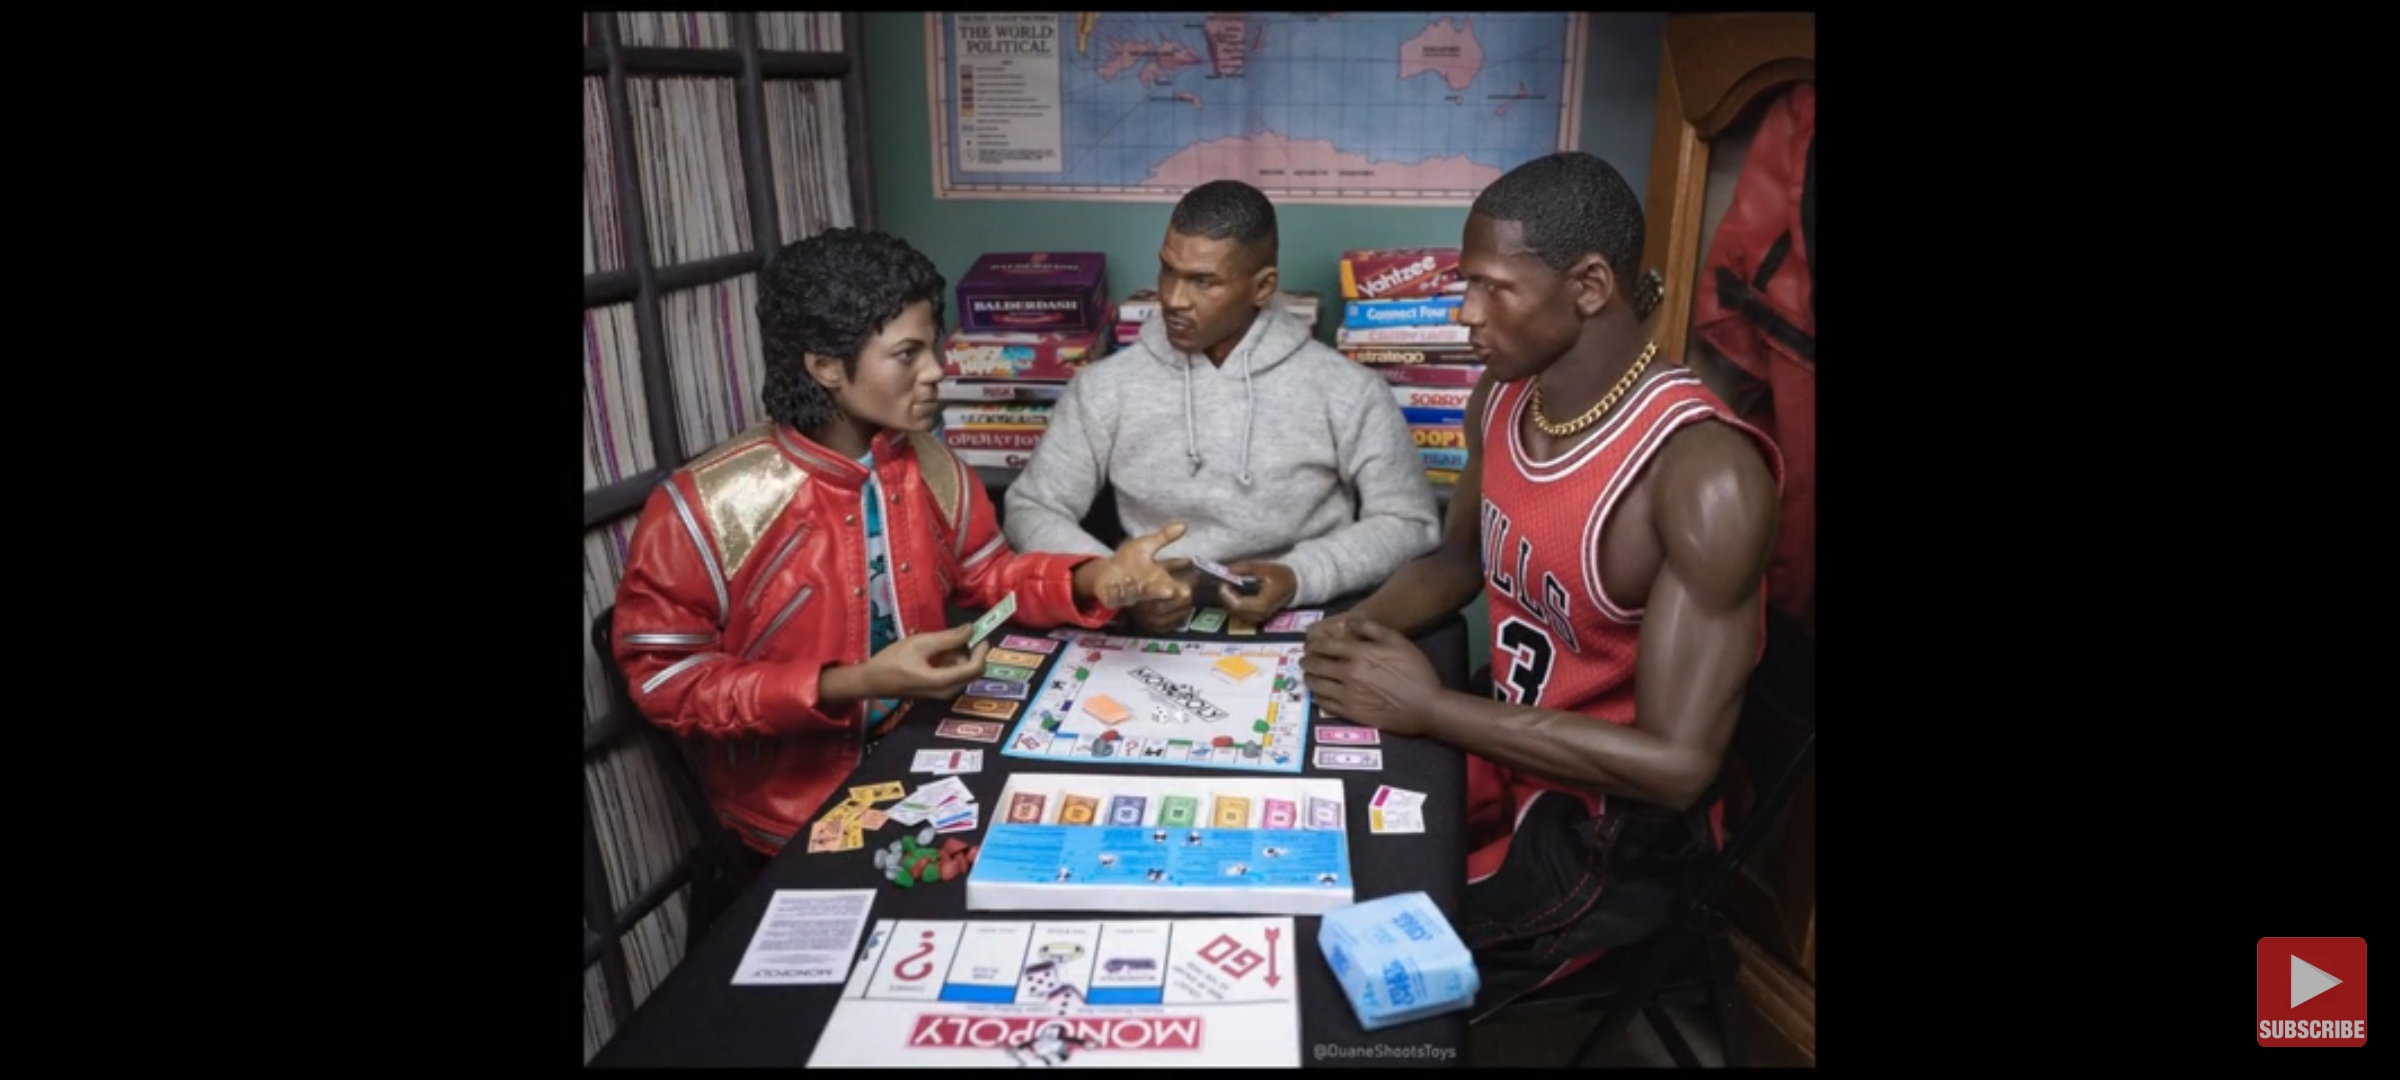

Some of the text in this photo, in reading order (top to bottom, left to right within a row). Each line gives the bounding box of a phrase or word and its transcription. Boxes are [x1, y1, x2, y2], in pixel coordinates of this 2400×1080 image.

[960, 25, 991, 39] THE
[967, 40, 1051, 53] POLITICAL
[1358, 256, 1435, 297] Yahtzee
[974, 301, 1077, 311] BALDERDASH
[1367, 305, 1447, 321] Connect Four
[1357, 351, 1425, 363] stratego
[1196, 933, 1265, 980] GO
[914, 1018, 1198, 1047] MONOPOLY
